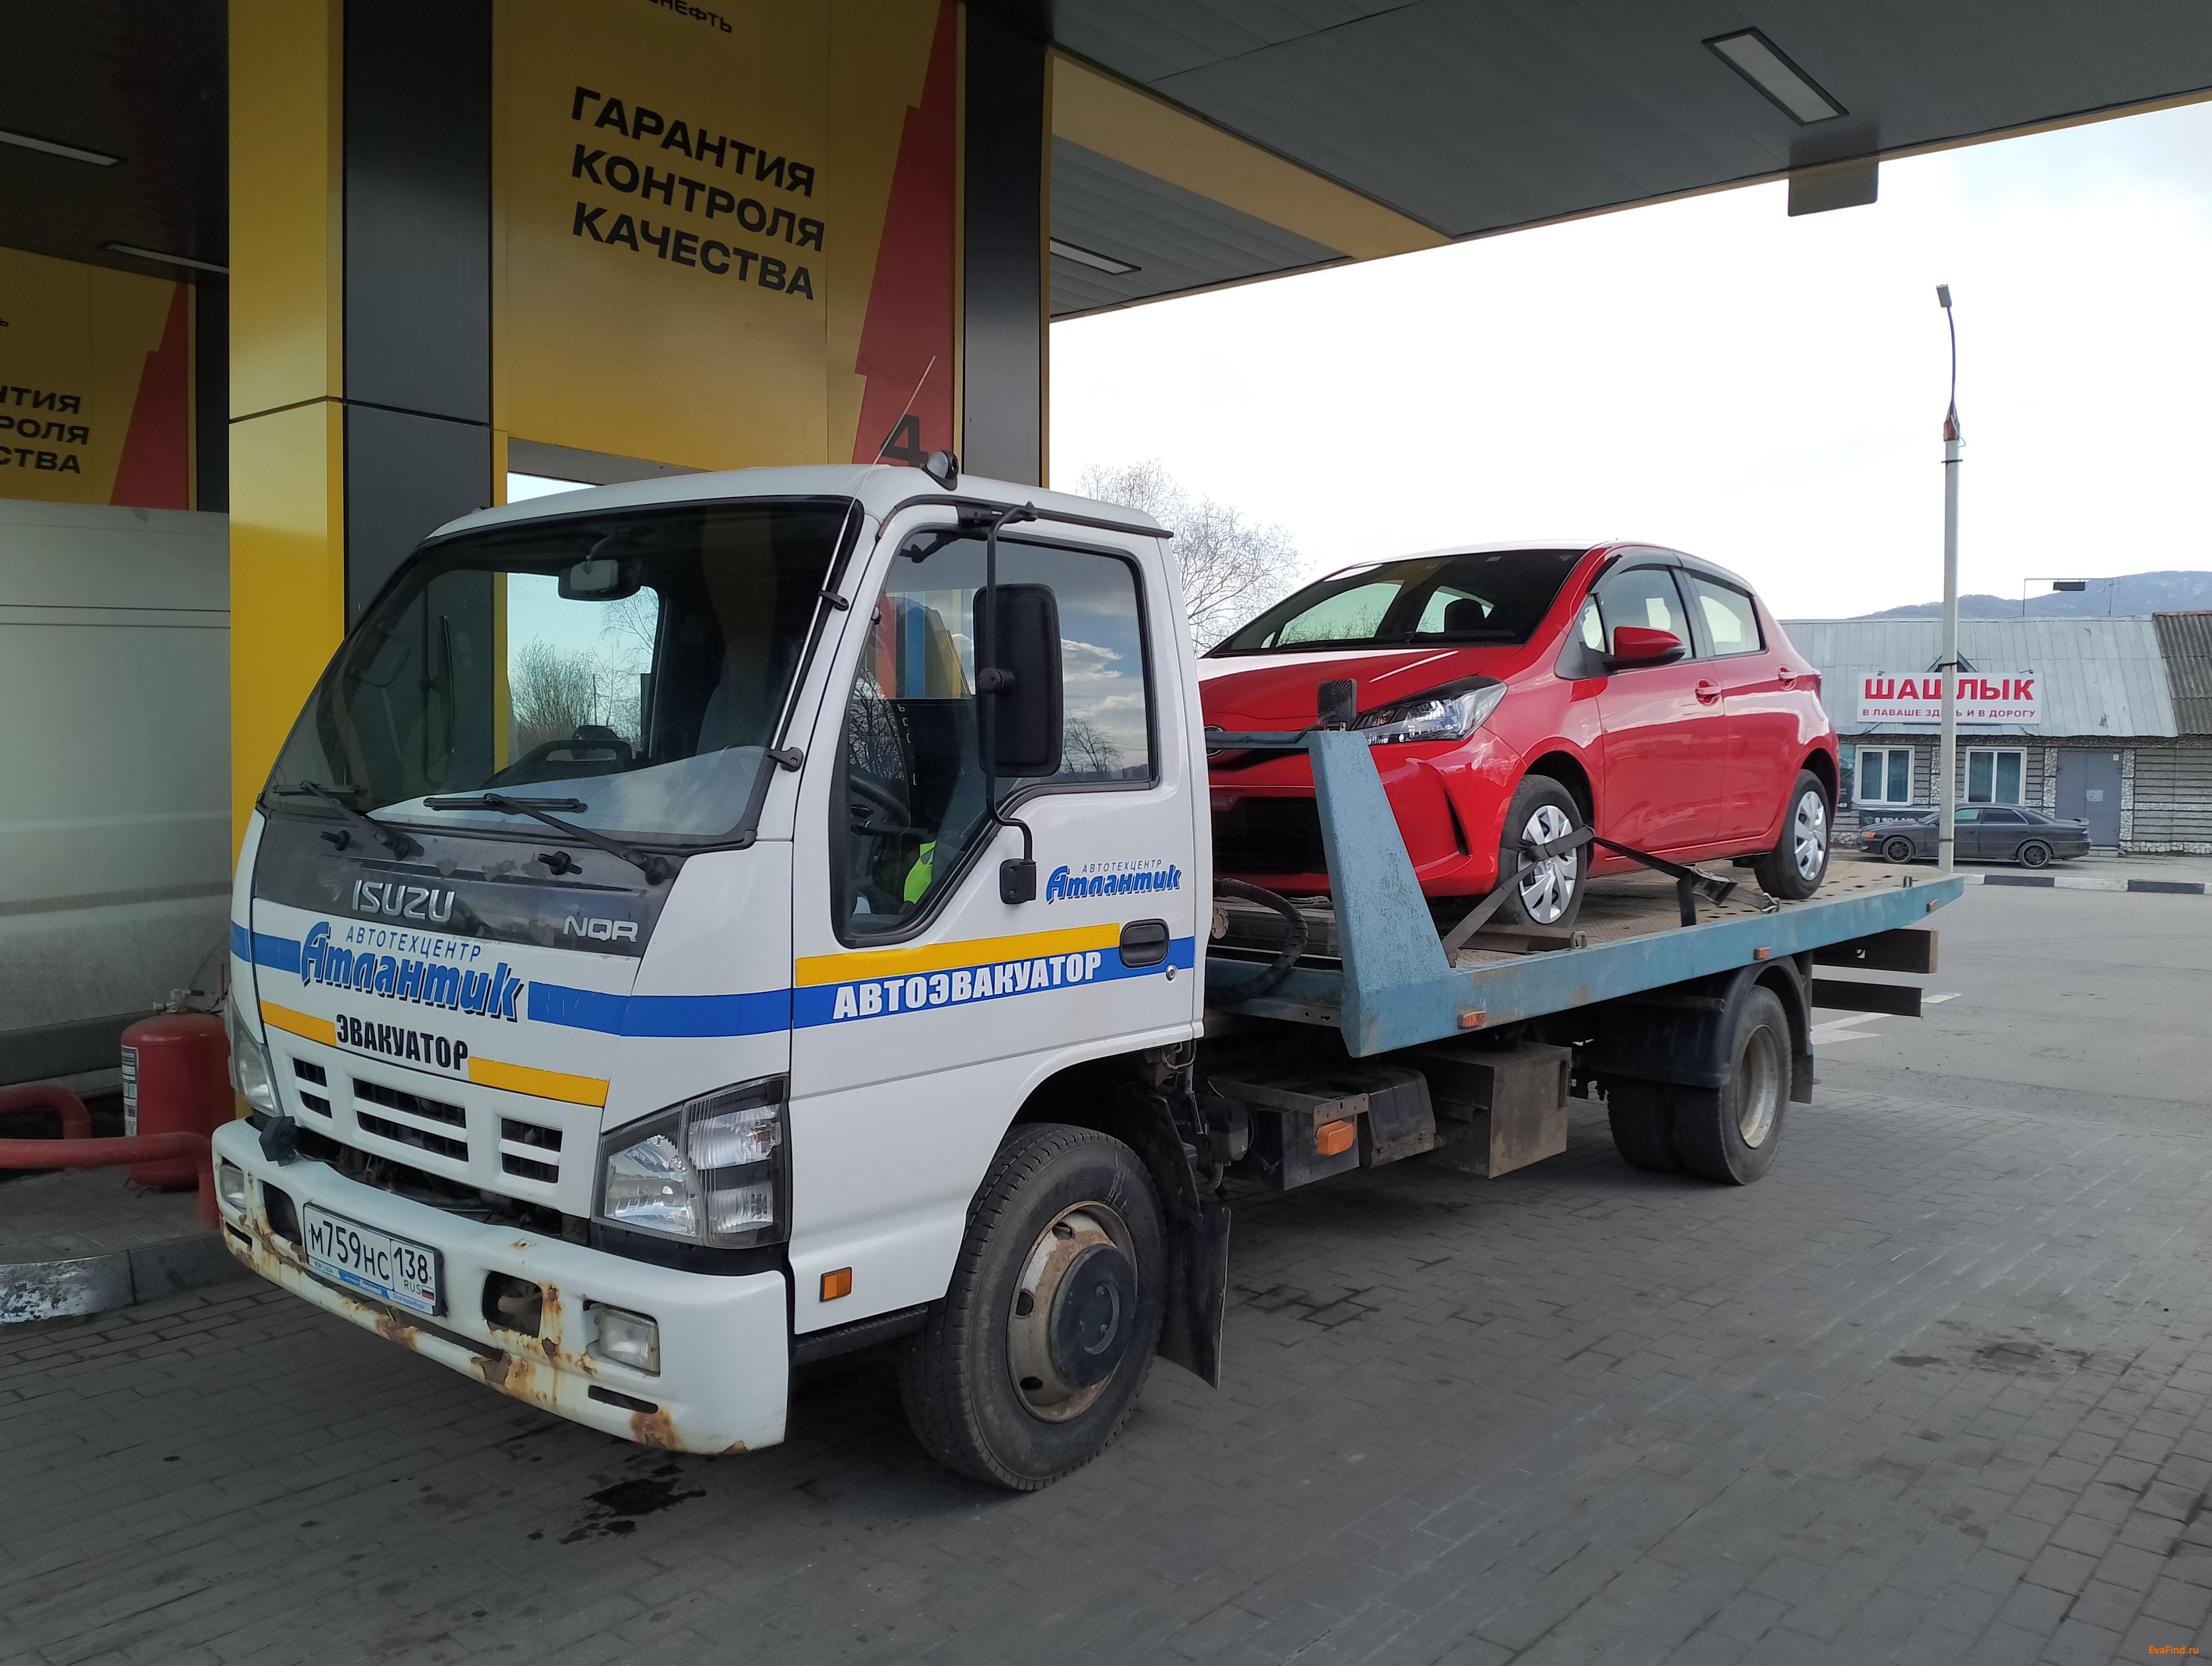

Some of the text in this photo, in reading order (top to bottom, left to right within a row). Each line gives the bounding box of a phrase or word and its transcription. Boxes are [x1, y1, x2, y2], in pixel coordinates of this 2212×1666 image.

[570, 86, 815, 197] ГАРАНТИЯ
[571, 144, 826, 253] КОНТРОЛЯ
[572, 201, 814, 301] КАЧЕСТВА
[880, 414, 929, 468] 4
[1925, 709, 1963, 718] ЗДЬ
[1989, 710, 2035, 718] ДОРОГУ
[1045, 864, 1182, 905] Атлантик
[1082, 859, 1162, 874] АВТОТЕХЦЕНТР
[352, 879, 456, 922] ISUZU
[345, 925, 481, 963] АВТОТЕХЦЕНТР
[563, 915, 639, 943] NQR
[300, 920, 524, 1023] Атлантик
[832, 951, 1102, 1020] АВТОЭВАКУАТОР
[336, 1014, 468, 1071] ЭВАКУАТОР
[403, 1279, 422, 1295] RUS
